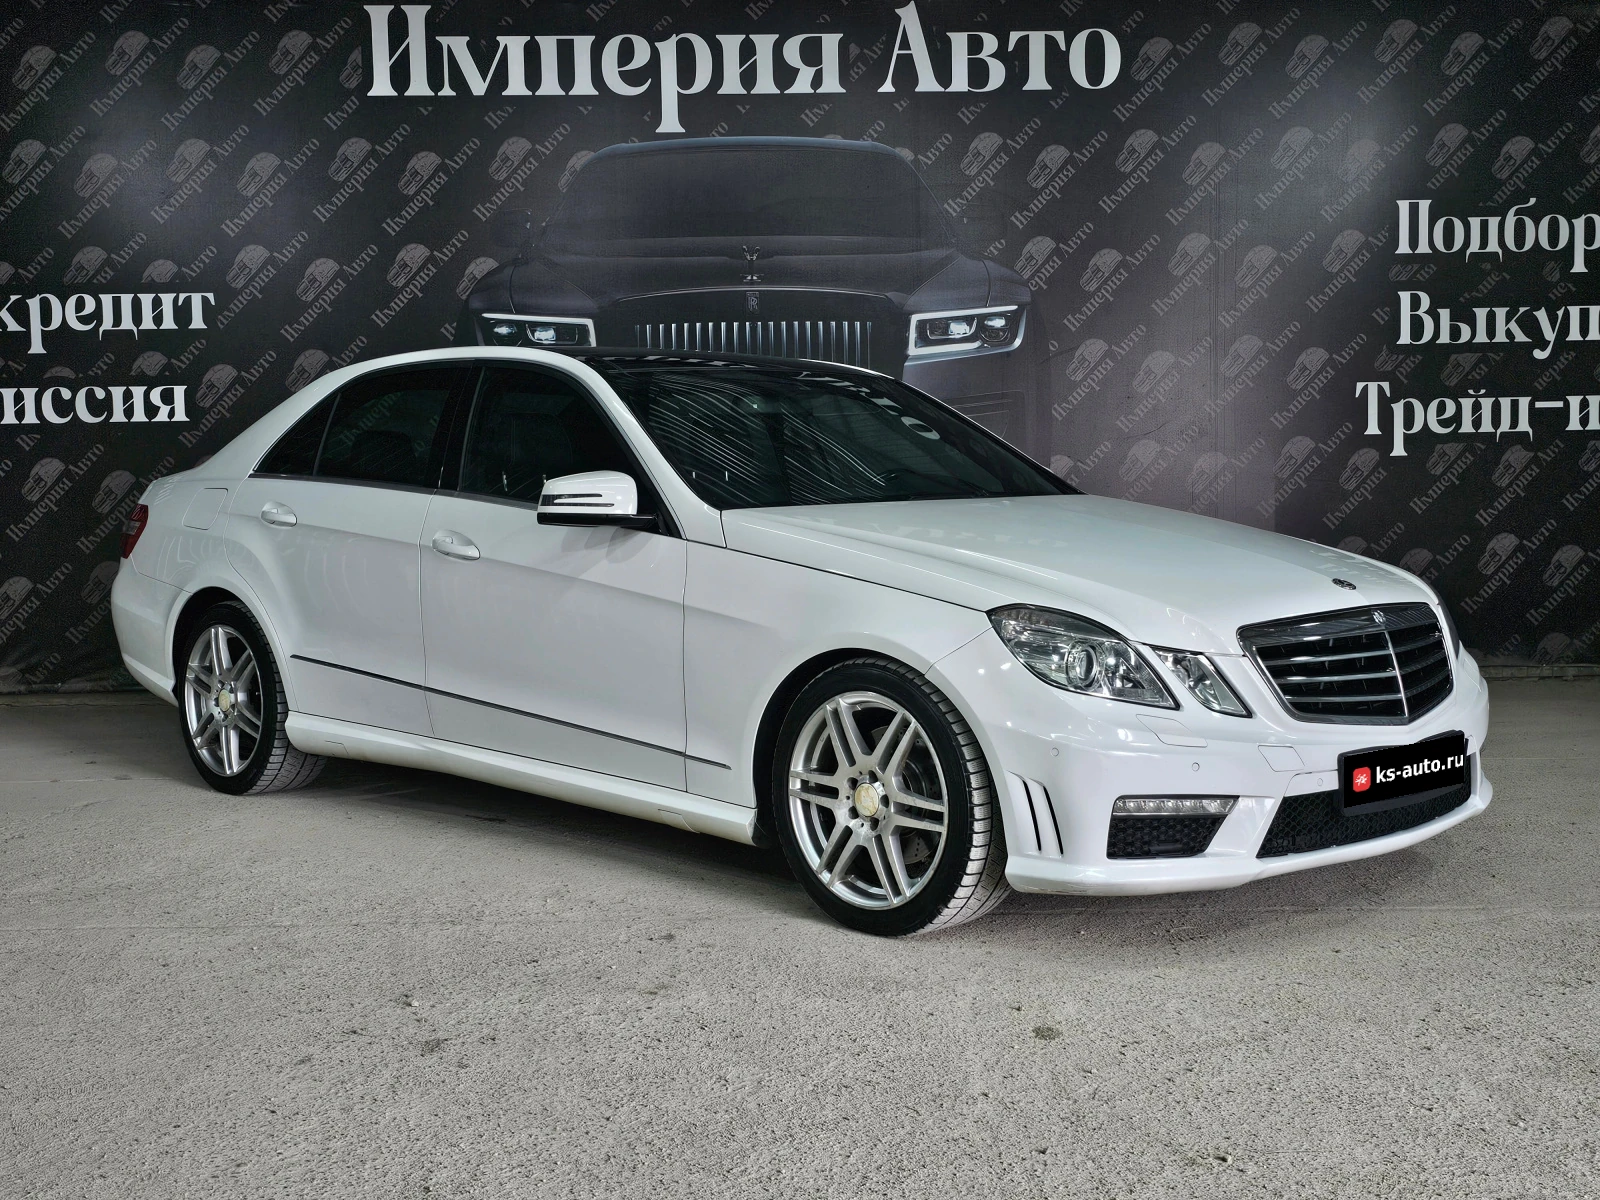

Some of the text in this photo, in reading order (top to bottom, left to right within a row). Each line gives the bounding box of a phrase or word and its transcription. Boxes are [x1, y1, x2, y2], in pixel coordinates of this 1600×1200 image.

[58, 31, 97, 69] Авто
[89, 55, 157, 118] Империя
[152, 17, 190, 55] Авто
[159, 31, 261, 132] Империя Авто
[252, 55, 320, 117] Империя
[315, 17, 353, 55] Авто
[364, 0, 1122, 133] Империя Авто
[1112, 24, 1213, 122] Империя Авто
[1202, 45, 1270, 107] Империя
[1265, 8, 1302, 45] Авто
[1268, 21, 1368, 119] Империя Авто
[1358, 5, 1458, 103] Империя Авто
[1424, 17, 1524, 116] Империя Авто
[49, 125, 88, 163] Авто
[150, 125, 251, 225] Империя Авто
[311, 162, 379, 224] Империя
[374, 124, 413, 162] Авто
[471, 161, 539, 223] Империя
[534, 123, 572, 161] Авто
[916, 133, 954, 170] Авто
[943, 155, 1010, 217] Империя
[1006, 118, 1043, 155] Авто
[1098, 116, 1198, 214] Империя Авто
[1471, 110, 1508, 146] Авто
[1537, 122, 1574, 159] Авто
[57, 139, 158, 240] Империя Авто
[219, 139, 321, 239] Империя Авто
[380, 138, 481, 238] Империя Авто
[1009, 131, 1110, 230] Империя Авто
[1164, 128, 1265, 227] Империя Авто
[16, 247, 55, 285] Авто
[110, 232, 148, 270] Авто
[180, 246, 218, 284] Авто
[272, 231, 310, 269] Авто
[369, 230, 470, 330] Империя Авто
[1058, 222, 1096, 259] Авто
[1150, 220, 1250, 318] Империя Авто
[1216, 232, 1316, 331] Империя Авто
[1395, 196, 1600, 273] Подбор
[278, 245, 379, 345] Империя Авто
[1061, 235, 1162, 334] Империя Авто
[1304, 253, 1372, 315] Империя
[1397, 289, 1600, 361] Выкуп
[169, 338, 208, 376] Авто
[175, 351, 277, 452] Империя Авто
[330, 336, 368, 374] Авто
[1048, 325, 1148, 424] Империя Авто
[1267, 335, 1367, 433] Империя Авто
[3, 483, 71, 545] Империя
[66, 445, 105, 483] Авто
[1076, 441, 1113, 478] Авто
[1253, 423, 1353, 522] Империя Авто
[1319, 472, 1386, 534] Империя
[1471, 468, 1539, 531] Империя
[34, 563, 73, 601] Авто
[1369, 522, 1406, 559] Авто
[1435, 534, 1472, 570] Авто
[1459, 519, 1559, 617] Империя Авто
[1524, 567, 1592, 629] Империя
